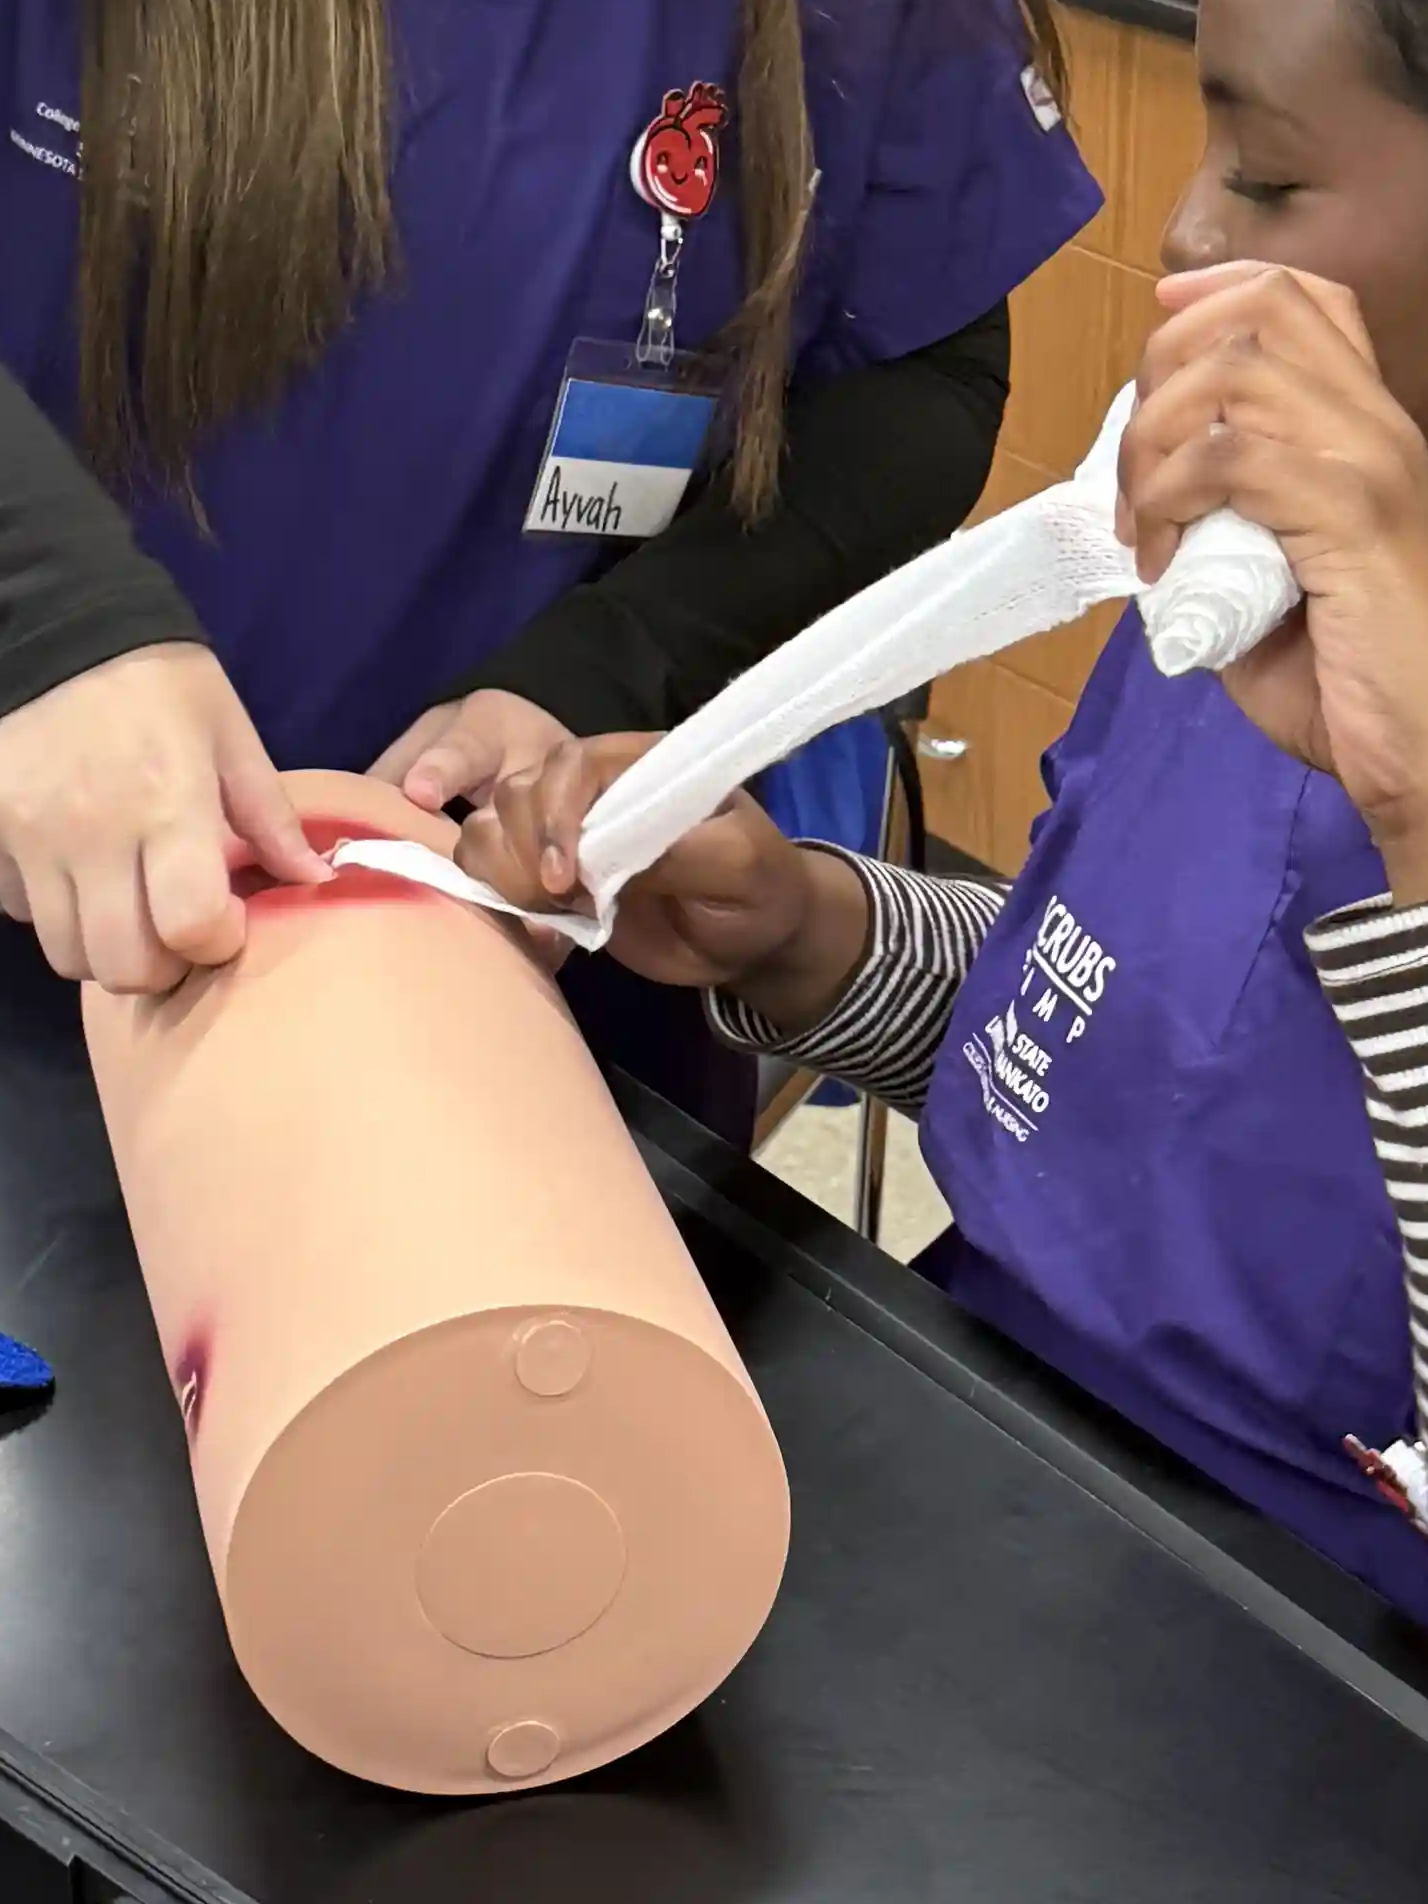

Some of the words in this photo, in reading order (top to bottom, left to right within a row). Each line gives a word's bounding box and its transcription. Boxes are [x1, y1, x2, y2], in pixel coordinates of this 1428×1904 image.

[540, 465, 622, 532] Ayvah
[1037, 895, 1116, 1003] CRUBS
[1011, 1033, 1053, 1077] STATE
